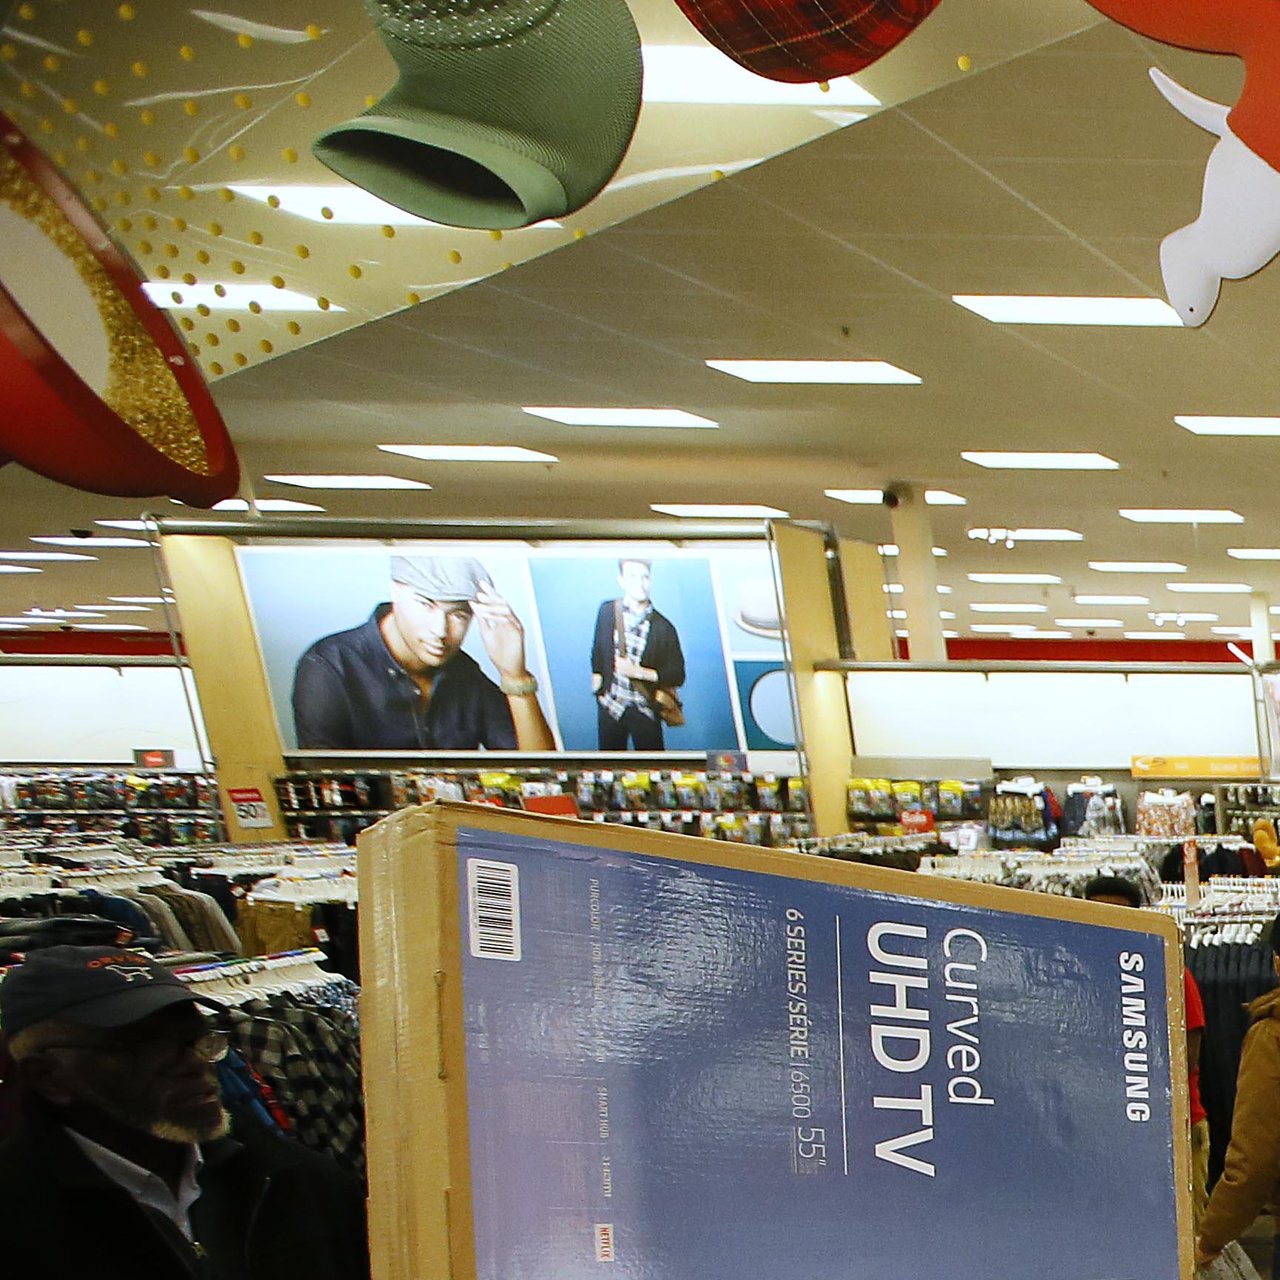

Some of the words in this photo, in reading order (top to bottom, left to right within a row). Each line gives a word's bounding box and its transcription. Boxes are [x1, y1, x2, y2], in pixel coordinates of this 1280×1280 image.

[589, 878, 601, 931] PURCOLOR
[786, 908, 804, 921] 6
[786, 926, 812, 1060] SERIES/SÉRIE
[867, 921, 932, 1074] UHD
[943, 927, 995, 1105] Curved
[1119, 951, 1152, 1123] SAMSUNG
[597, 1087, 609, 1117] SMART
[789, 1069, 811, 1119] 6500
[598, 1118, 609, 1139] HUB
[873, 1084, 937, 1178] TV
[599, 1226, 612, 1259] NETFLIX
